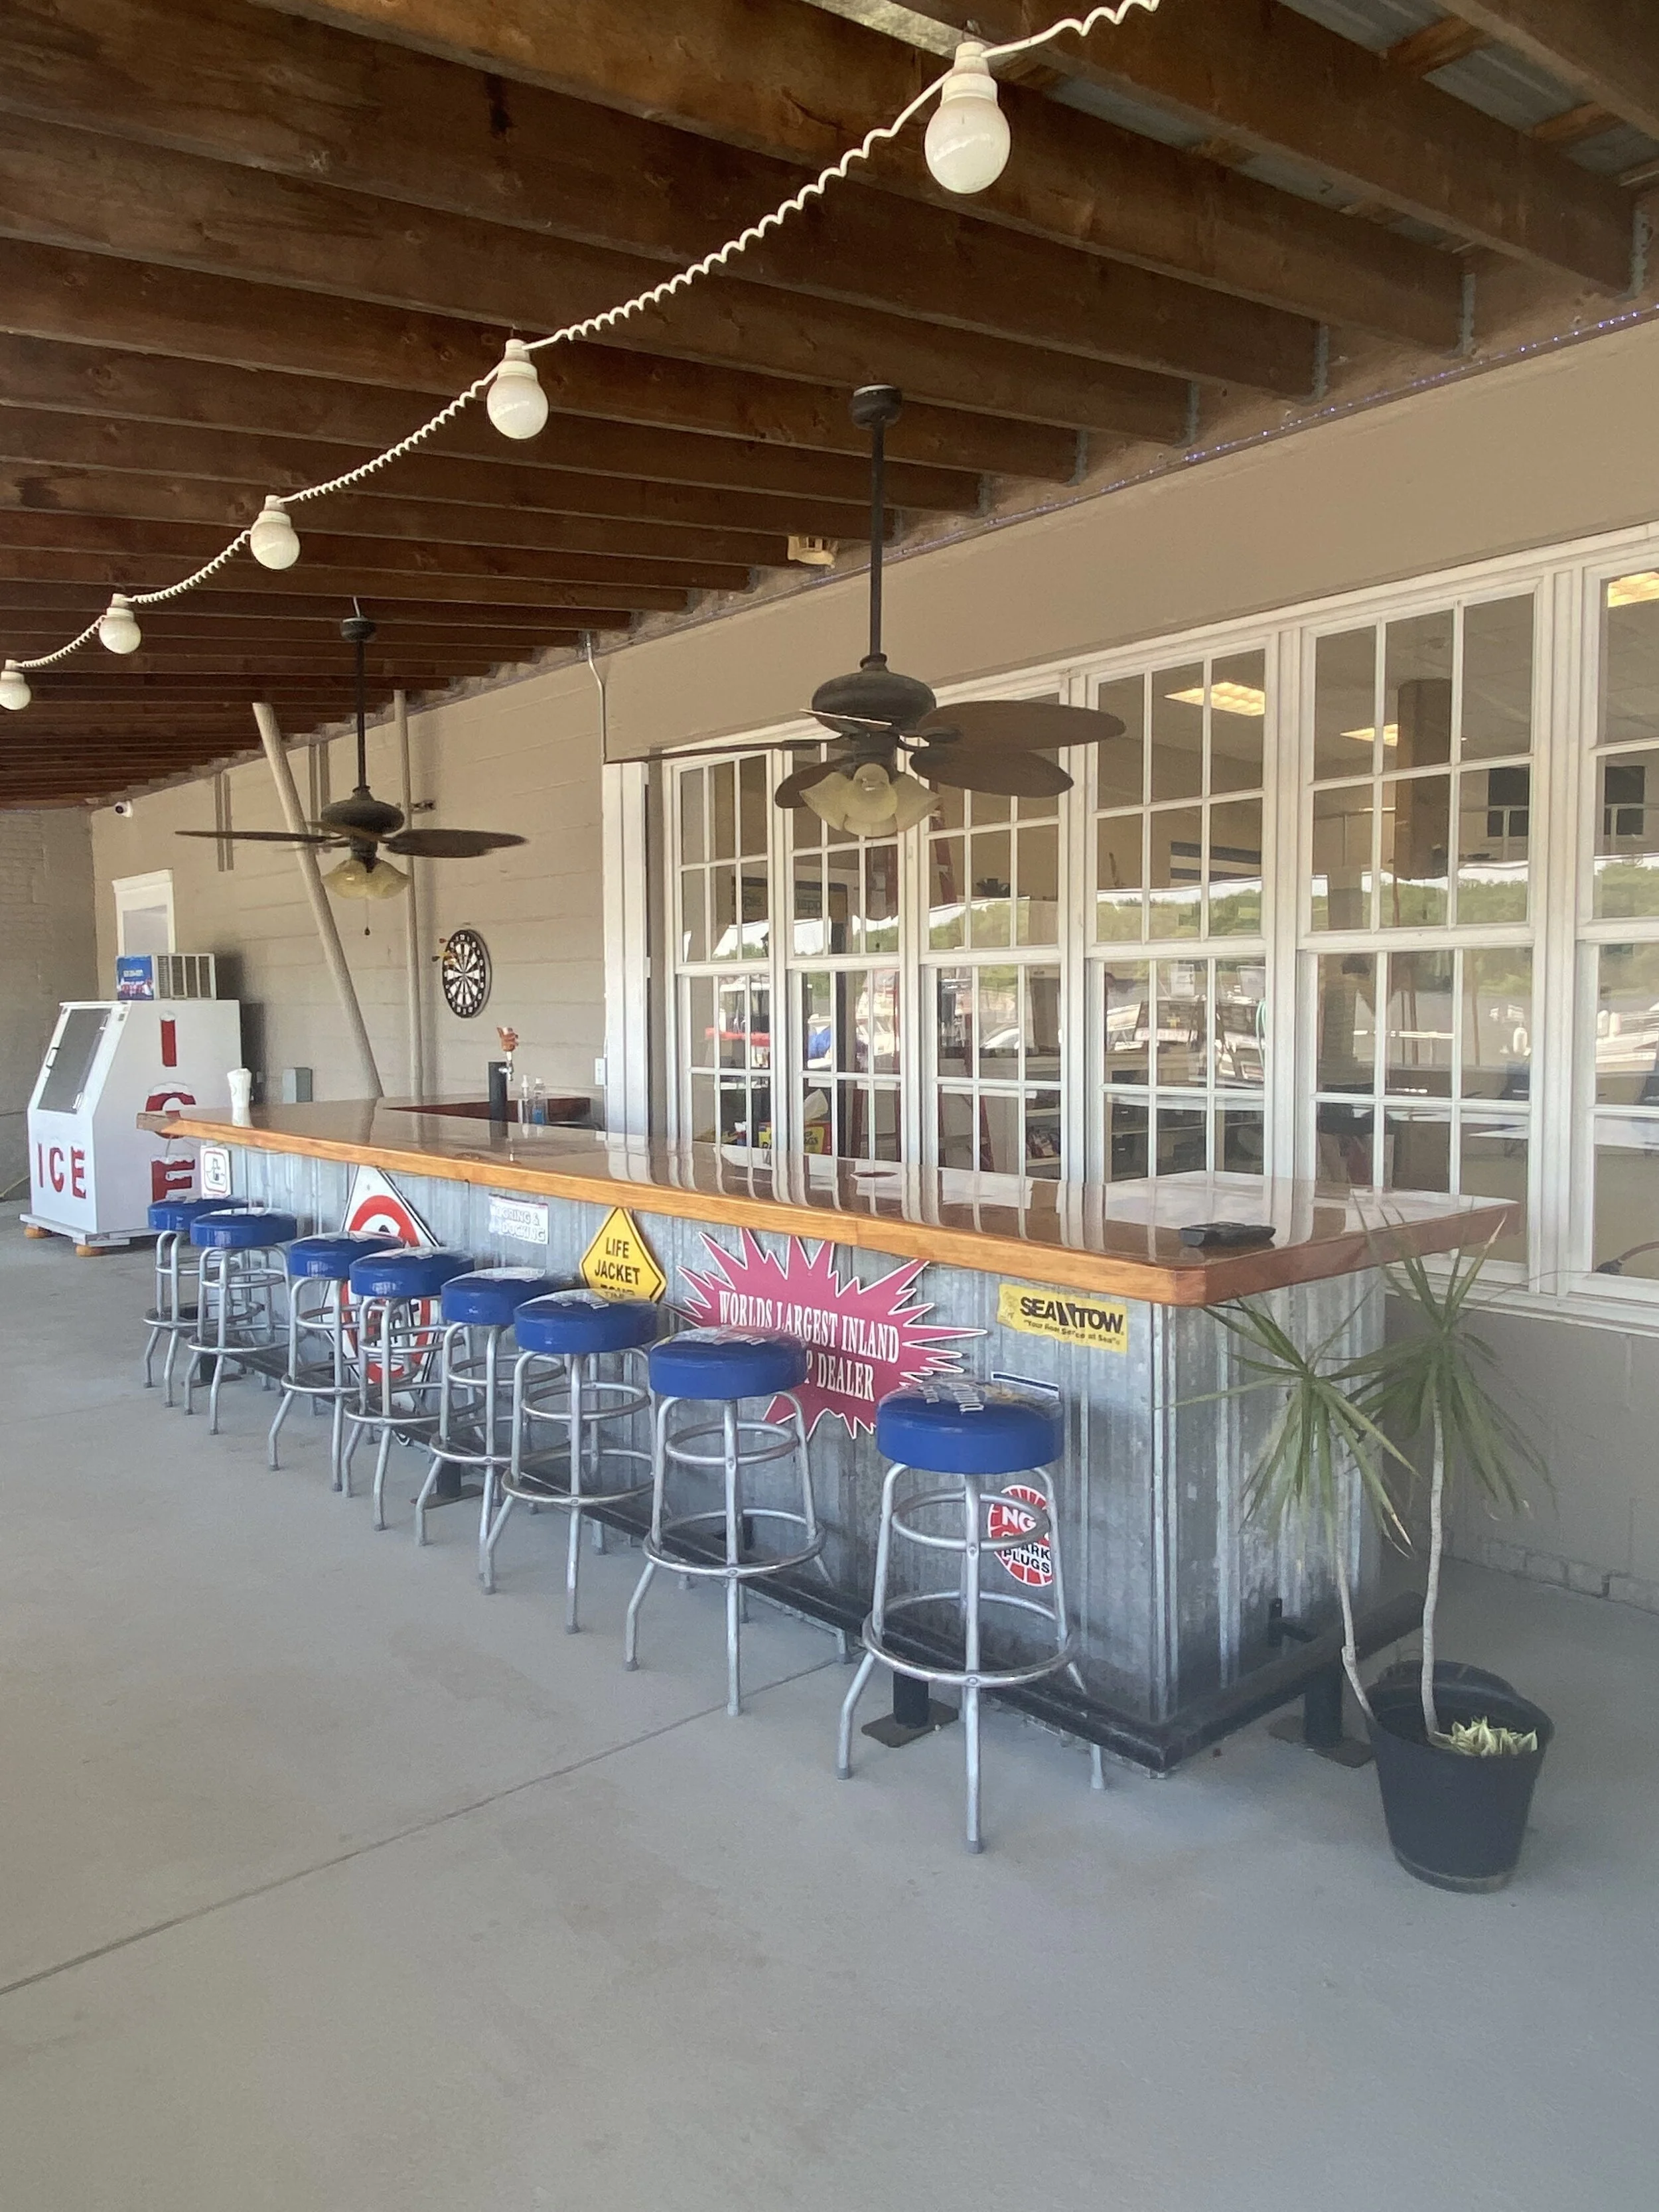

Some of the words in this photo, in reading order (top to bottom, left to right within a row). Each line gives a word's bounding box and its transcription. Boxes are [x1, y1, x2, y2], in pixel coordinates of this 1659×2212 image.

[37, 1140, 87, 1199] ICE
[606, 1237, 630, 1259] LIFE
[595, 1260, 640, 1286] JACKET
[718, 1290, 772, 1329] WORLDS
[775, 1301, 838, 1349] LARGEST
[841, 1315, 900, 1363] INLAND
[817, 1353, 875, 1402] DEALER
[1002, 1505, 1037, 1533] NG
[1003, 1548, 1050, 1574] PLUGS
